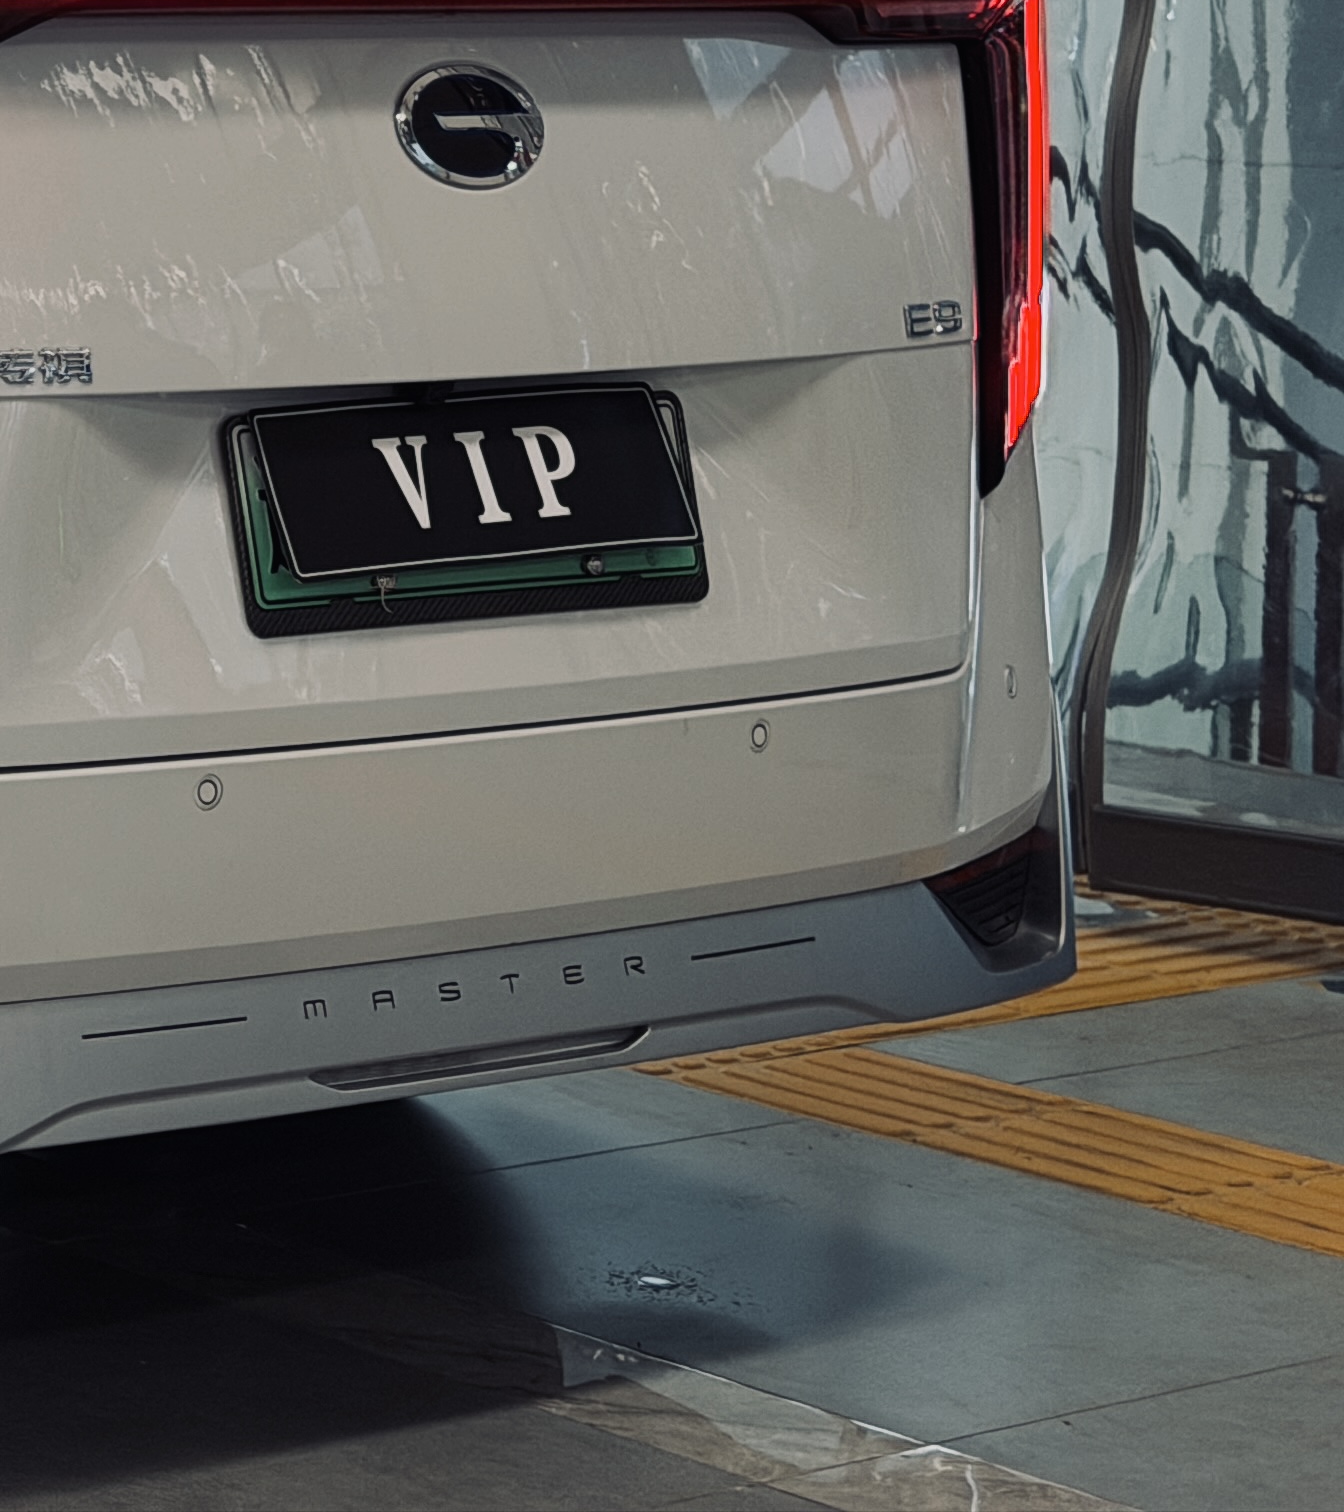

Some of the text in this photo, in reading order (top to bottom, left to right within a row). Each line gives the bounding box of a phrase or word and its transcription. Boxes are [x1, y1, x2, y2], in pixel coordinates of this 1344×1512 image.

[902, 299, 963, 338] E9
[371, 425, 577, 530] VIP
[302, 955, 646, 1020] MASTER
